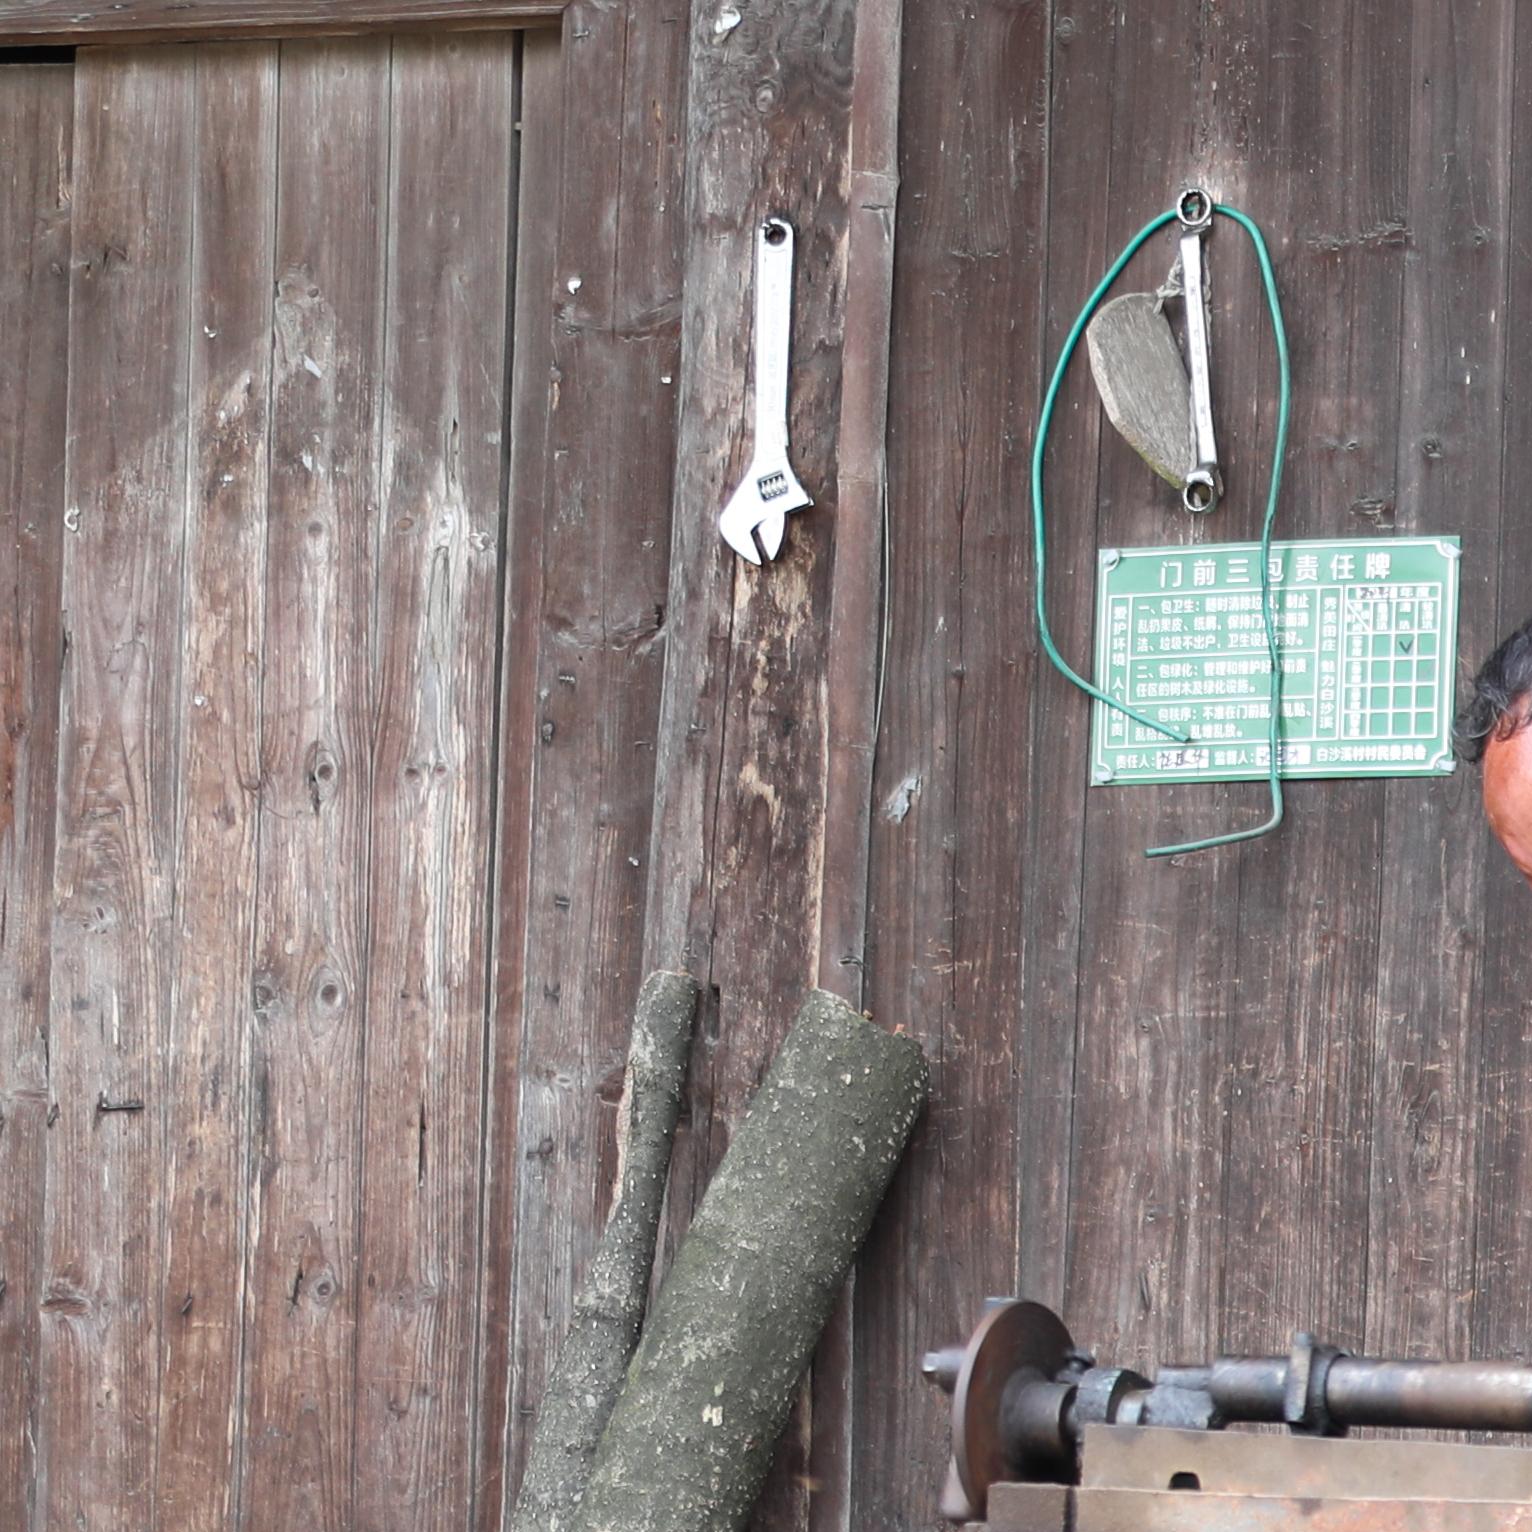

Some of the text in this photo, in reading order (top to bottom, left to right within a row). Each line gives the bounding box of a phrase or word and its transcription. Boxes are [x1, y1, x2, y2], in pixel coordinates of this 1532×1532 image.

[1160, 553, 1391, 588] 门前三包责任牌
[1112, 605, 1127, 667] 爱护环境
[1321, 597, 1338, 652] 秀美田庄
[1316, 743, 1426, 762] 白沙溪村村民委员会
